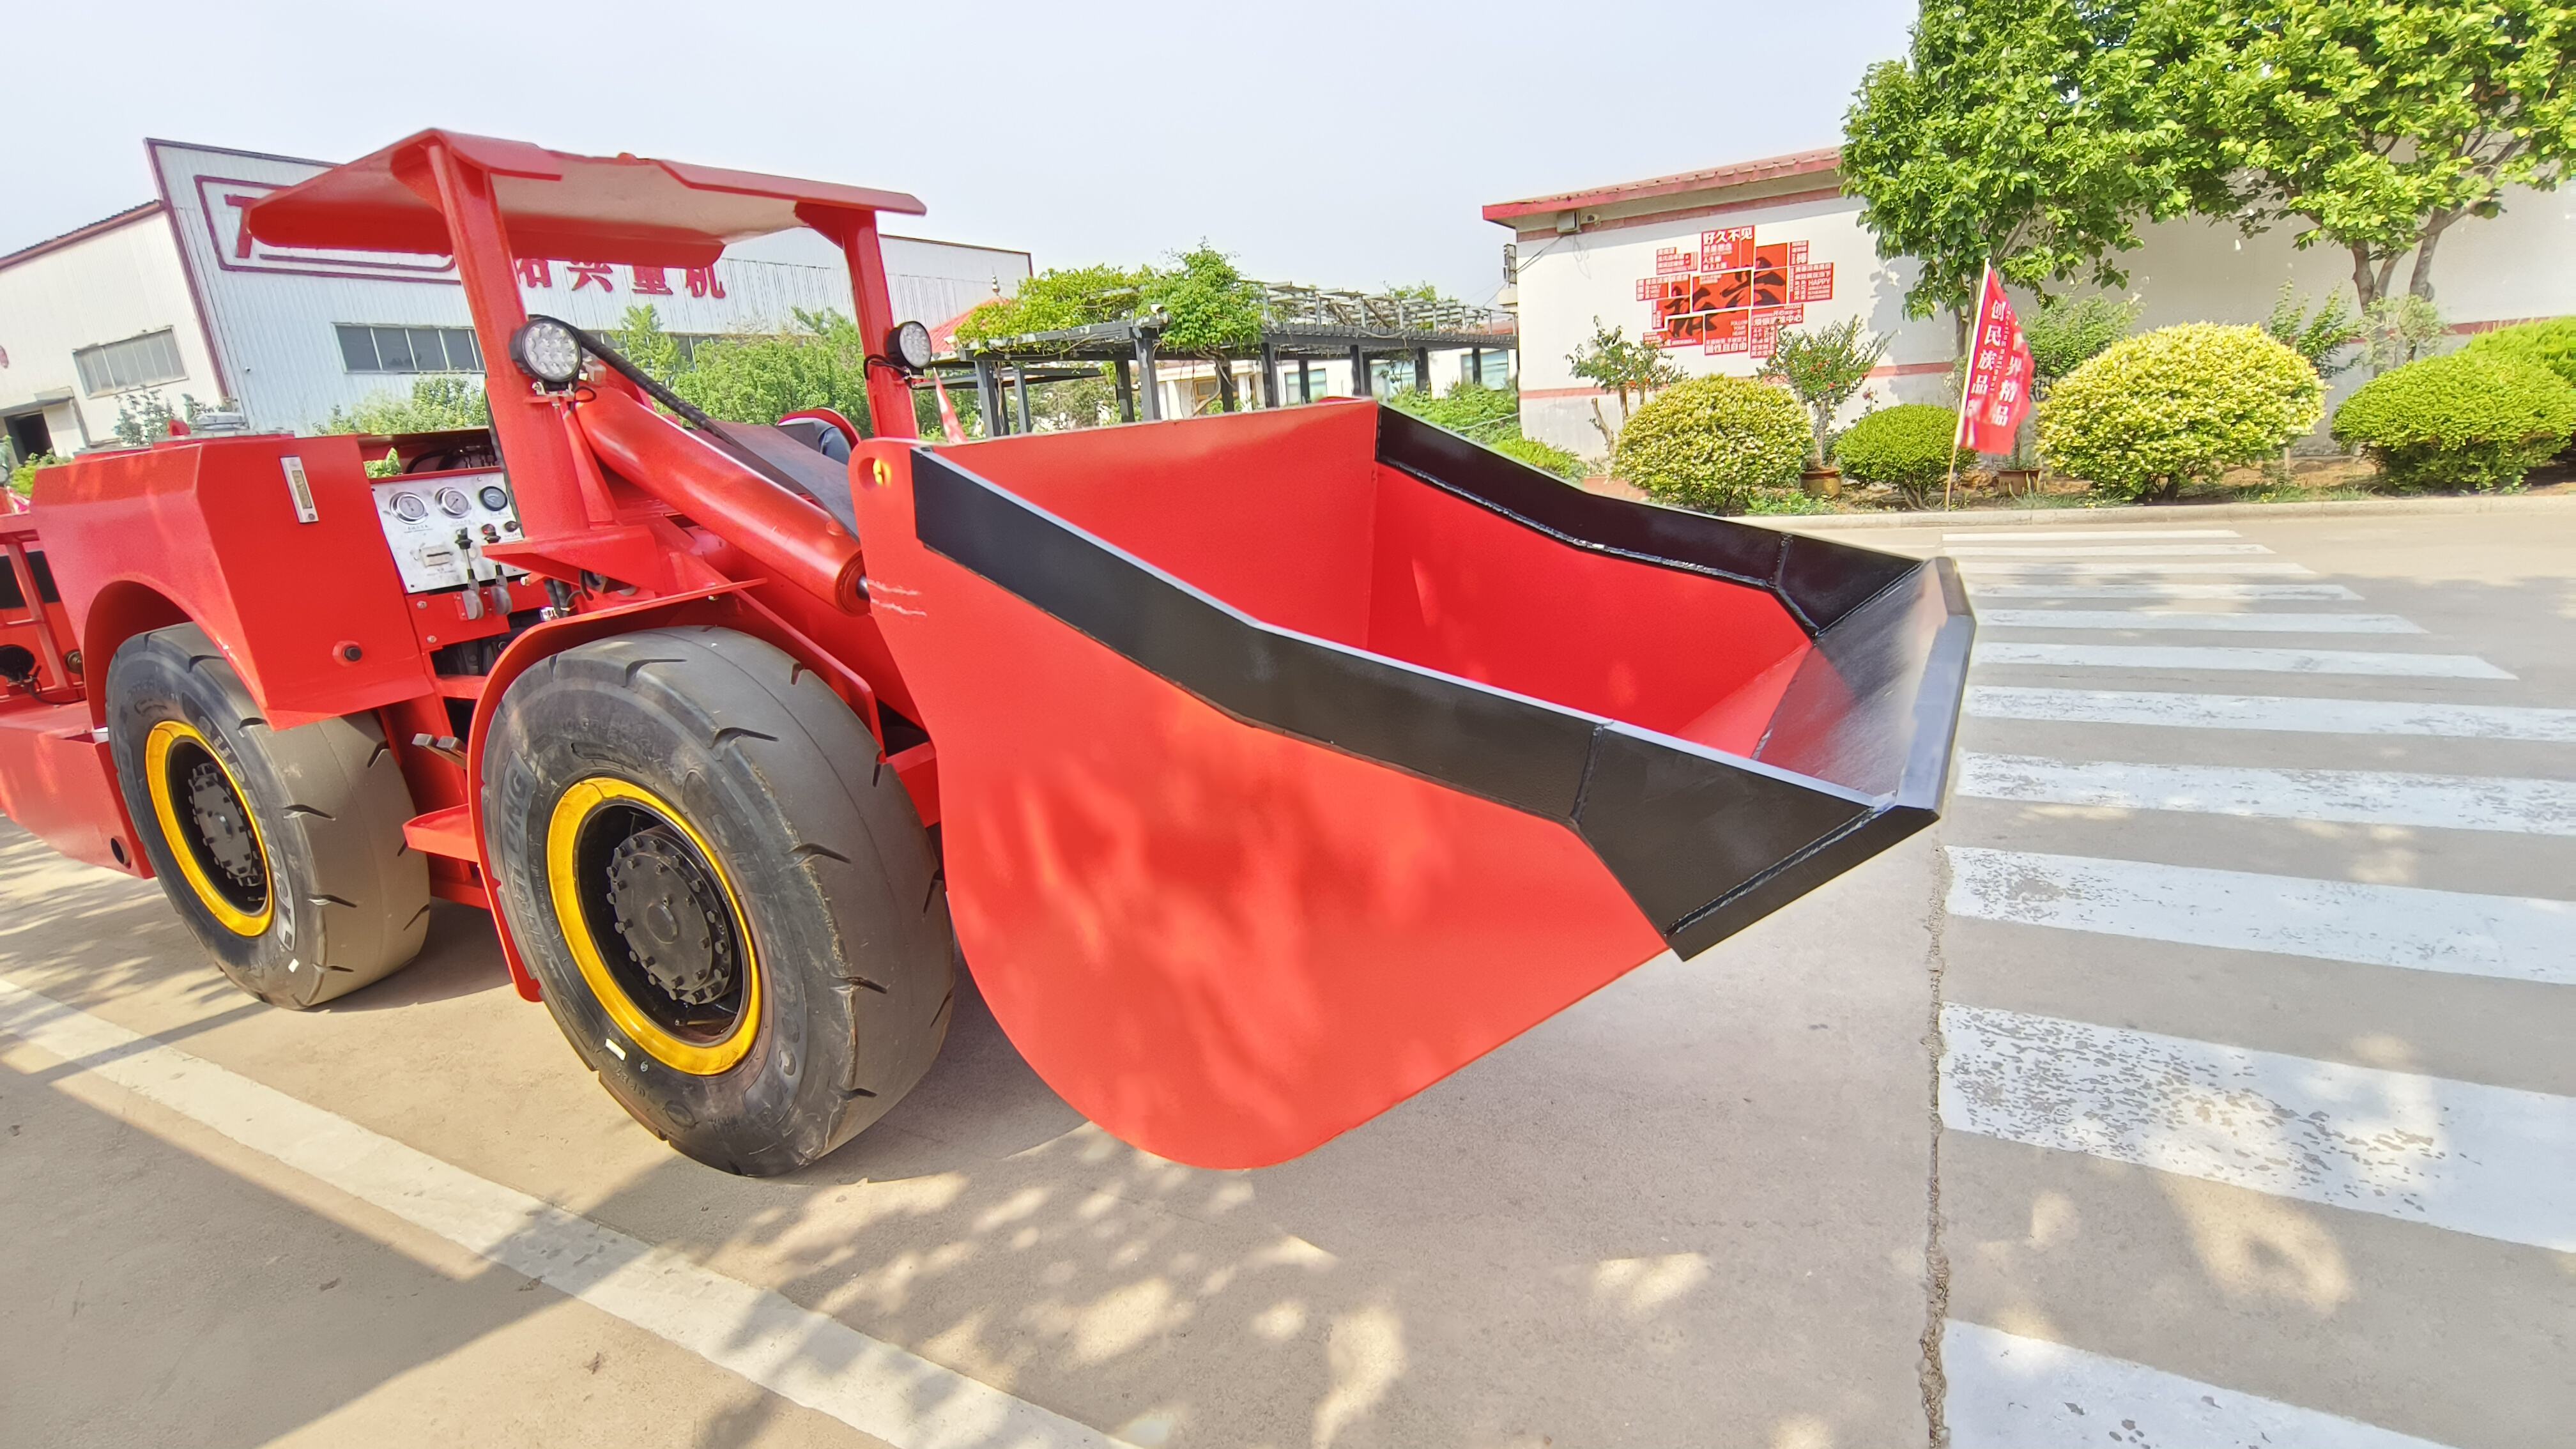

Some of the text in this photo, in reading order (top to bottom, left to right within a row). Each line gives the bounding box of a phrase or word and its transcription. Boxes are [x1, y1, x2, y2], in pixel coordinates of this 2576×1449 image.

[1703, 227, 1753, 246] 好久不见
[1807, 277, 1830, 286] HAPPY
